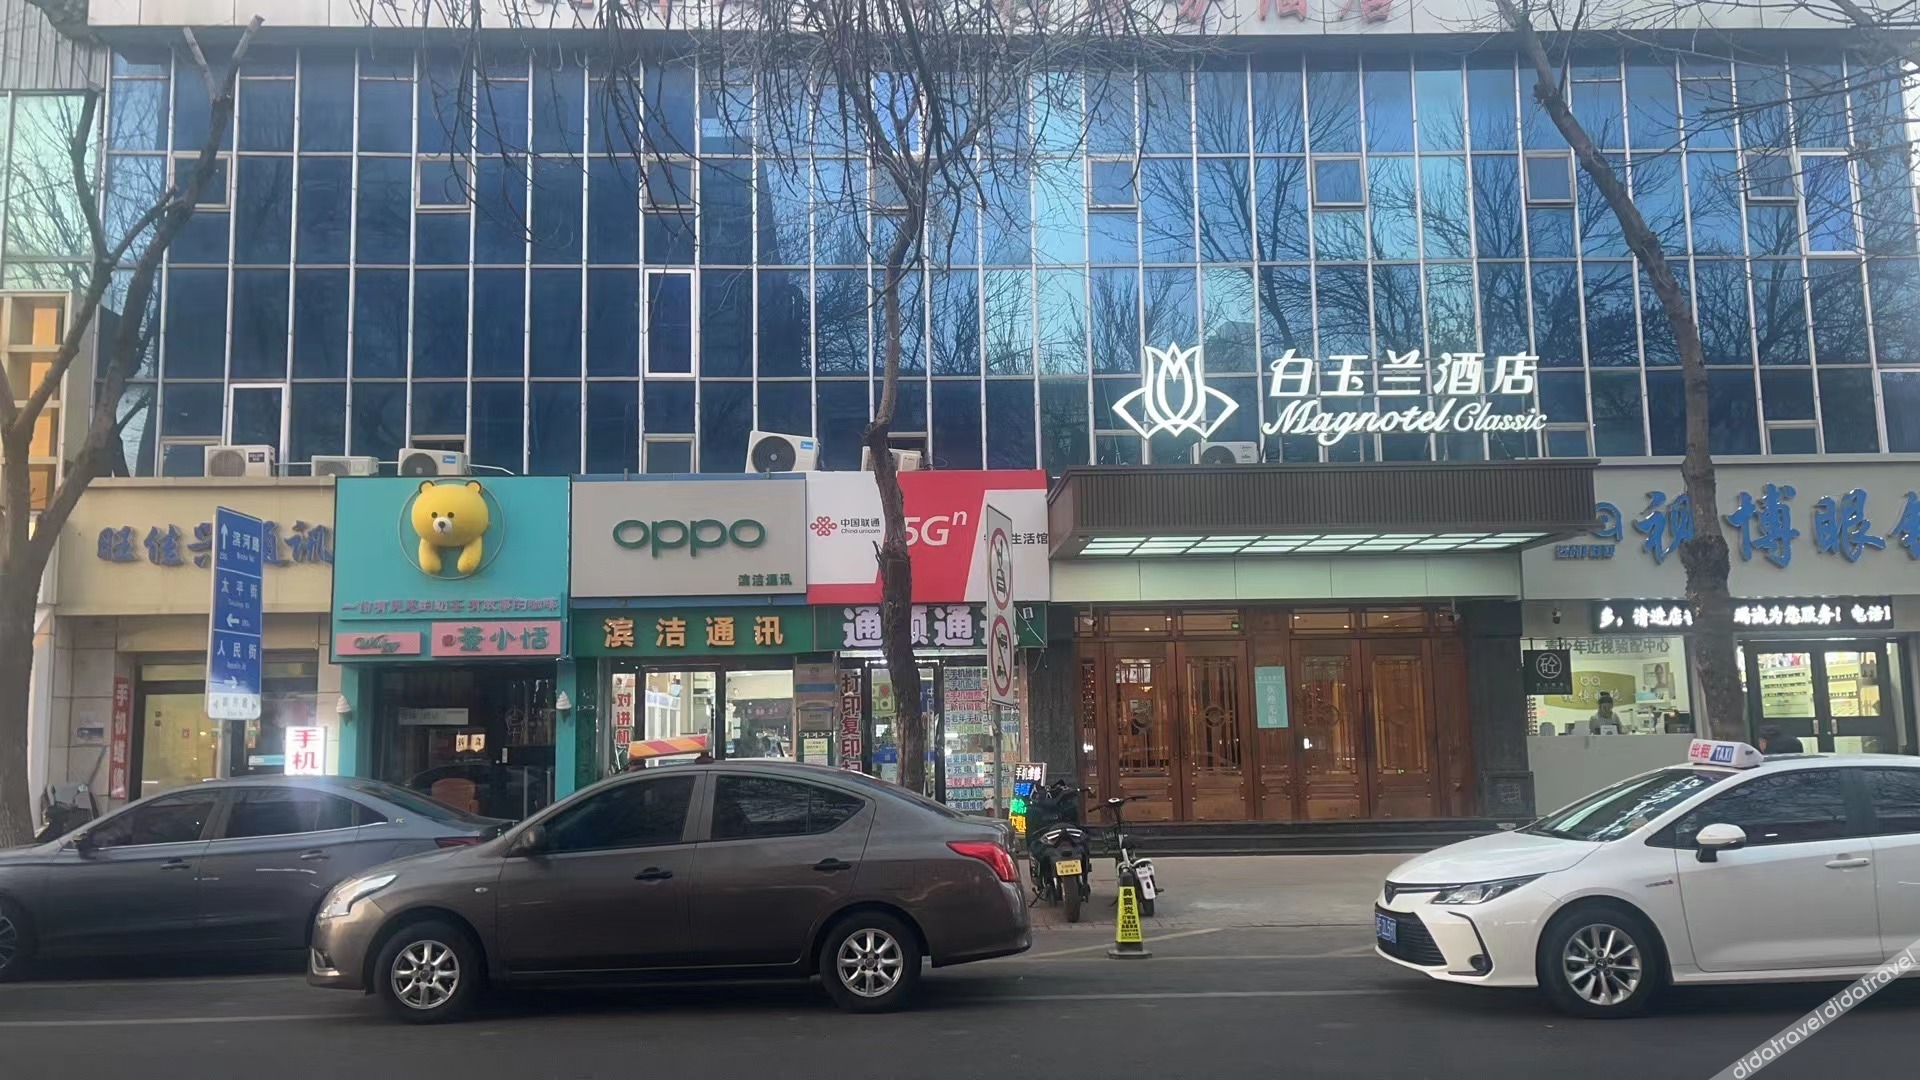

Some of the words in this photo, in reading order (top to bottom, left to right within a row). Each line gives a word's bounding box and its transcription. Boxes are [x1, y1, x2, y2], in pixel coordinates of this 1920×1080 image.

[1271, 348, 1541, 397] 白玉兰酒店
[1262, 399, 1450, 447] Magnotel
[1454, 403, 1548, 432] Classic
[841, 518, 880, 528] 中国联通
[221, 577, 258, 600] 太平街
[603, 616, 783, 648] 滨洁通讯
[843, 605, 1019, 648] 通通
[217, 640, 258, 660] 人民街
[616, 693, 631, 744] 对讲机
[1690, 743, 1712, 759] 出租
[1715, 746, 1734, 761] TAXI
